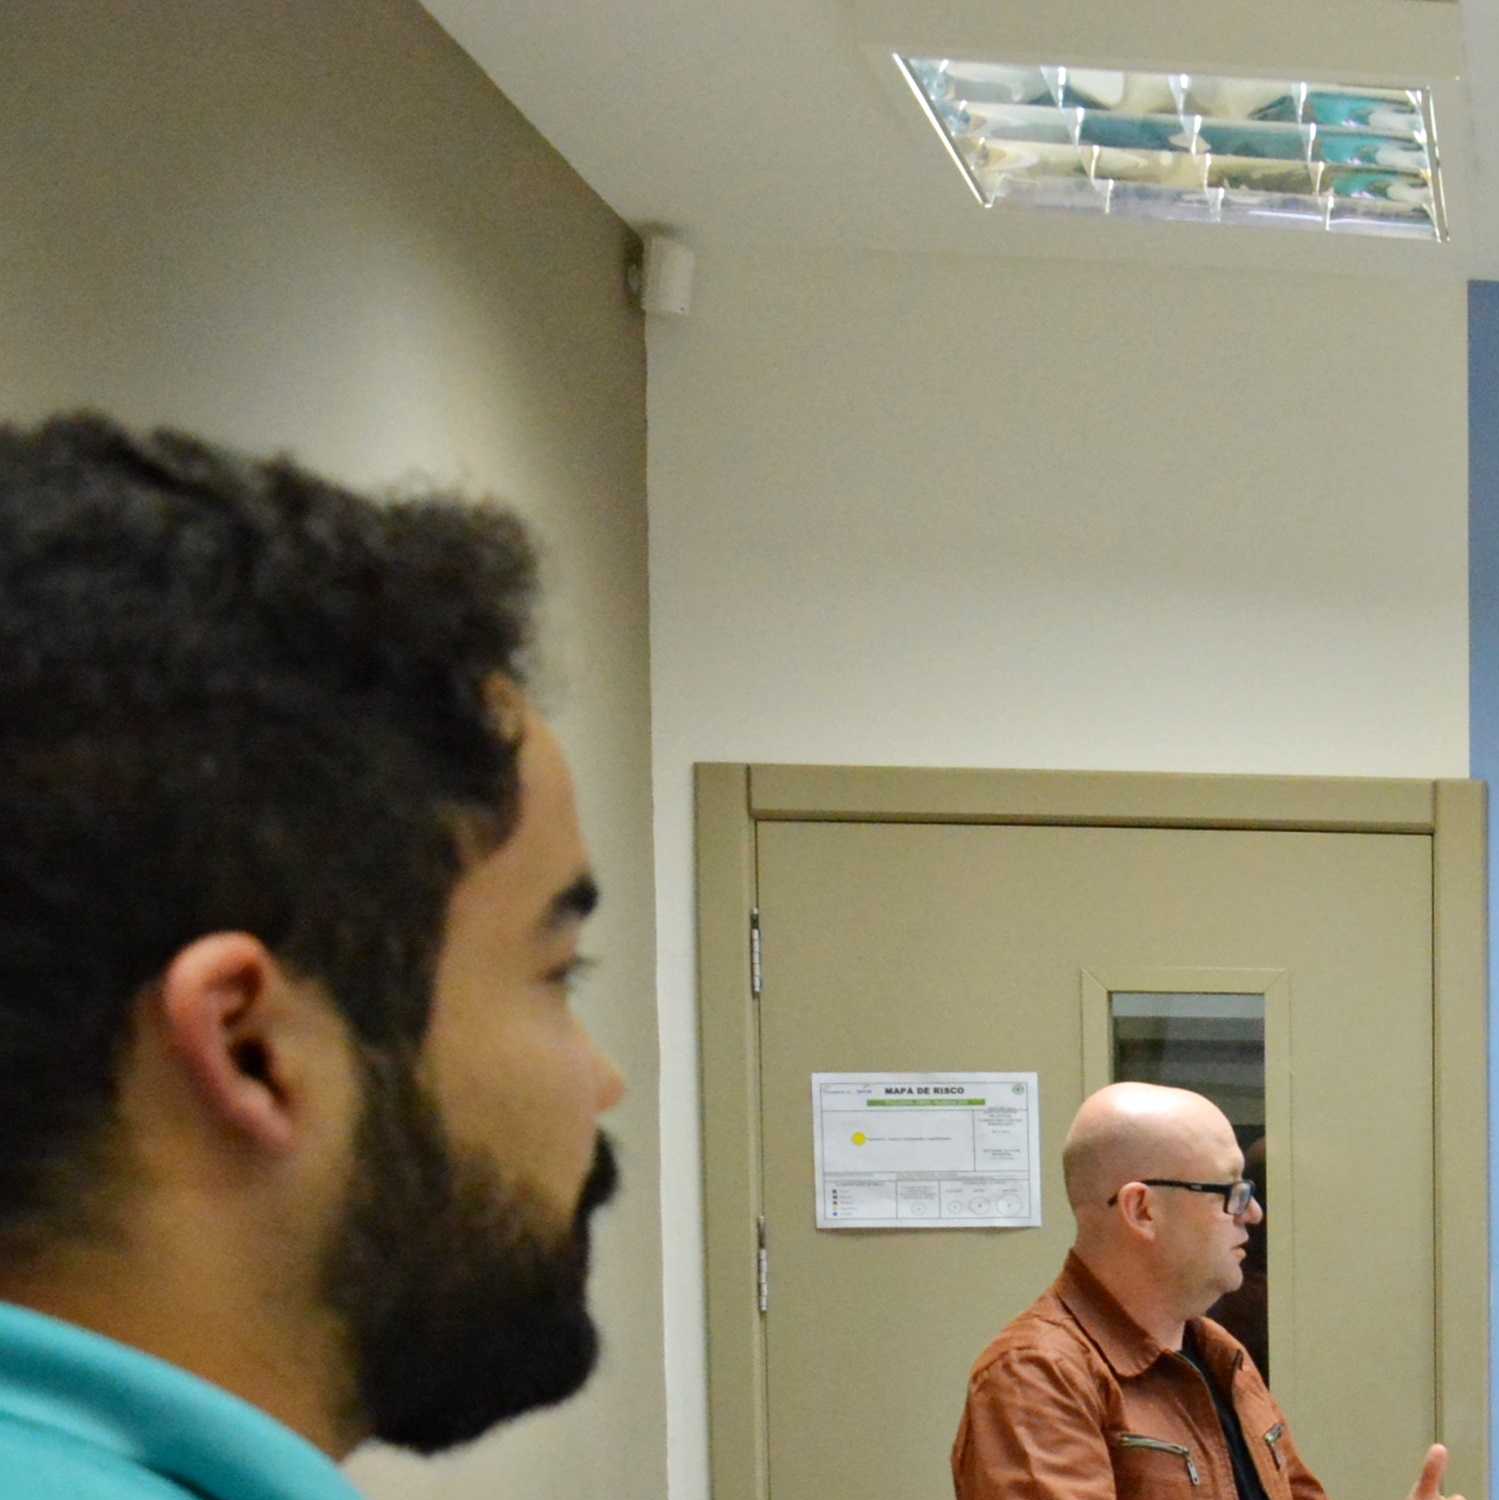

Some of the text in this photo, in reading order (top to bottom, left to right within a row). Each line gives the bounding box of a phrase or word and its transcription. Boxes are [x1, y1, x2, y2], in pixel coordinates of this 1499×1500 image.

[884, 1086, 965, 1095] MAPA DE RISCO
